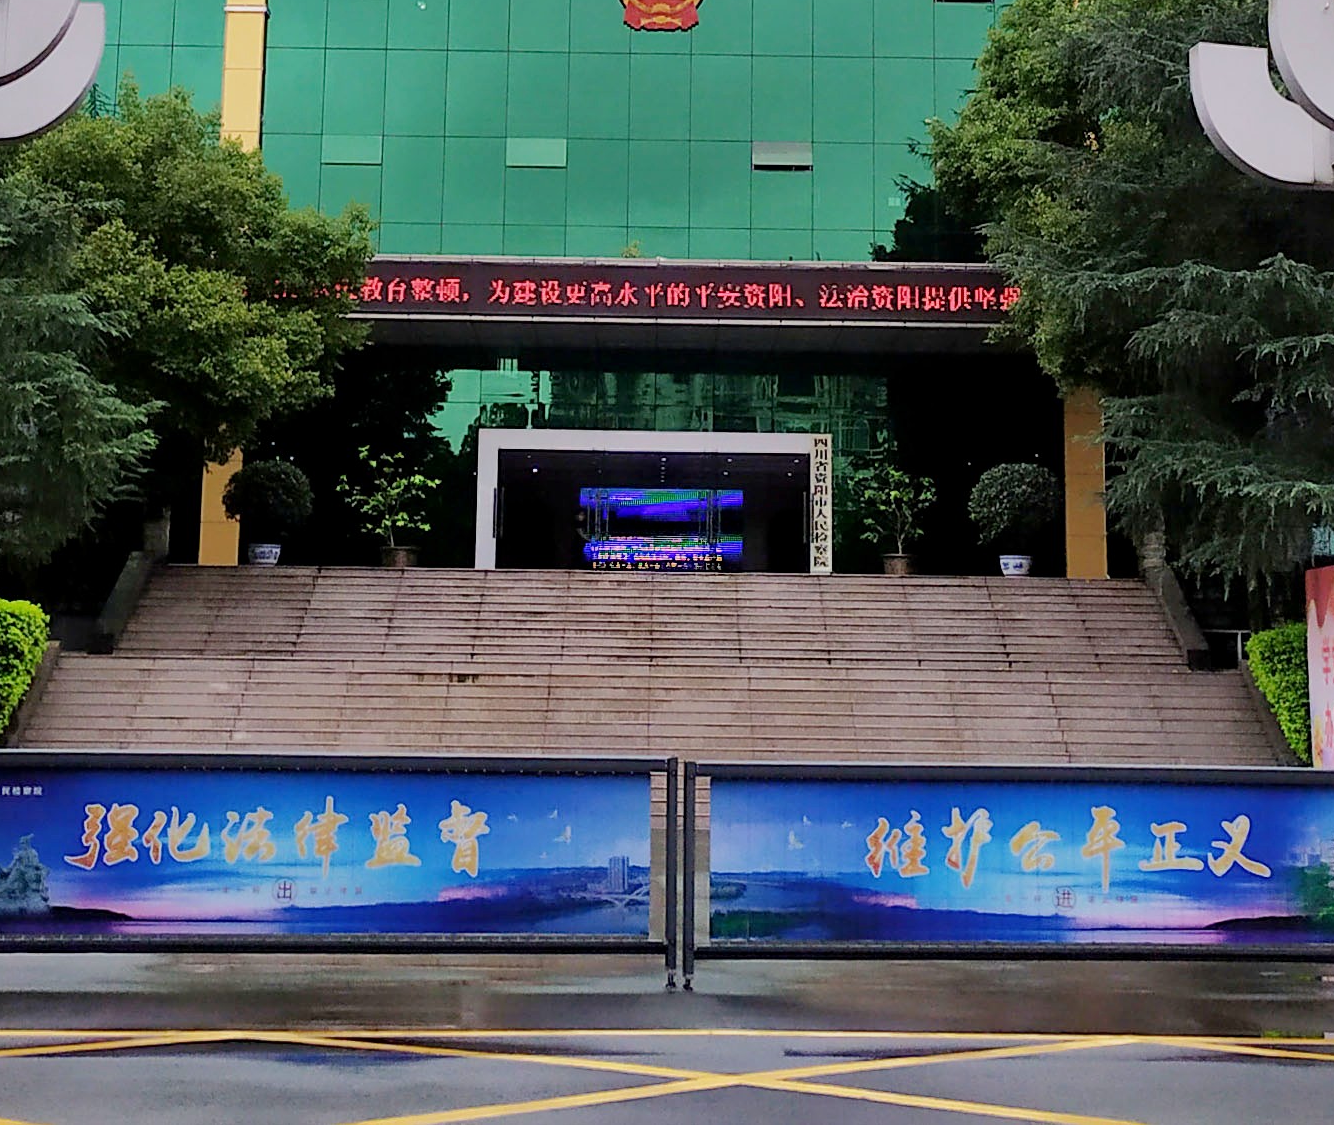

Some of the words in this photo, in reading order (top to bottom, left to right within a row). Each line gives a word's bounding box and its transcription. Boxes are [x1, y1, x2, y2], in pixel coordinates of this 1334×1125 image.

[63, 794, 490, 878] 强化法律监督
[865, 806, 1272, 893] 维护公平正义
